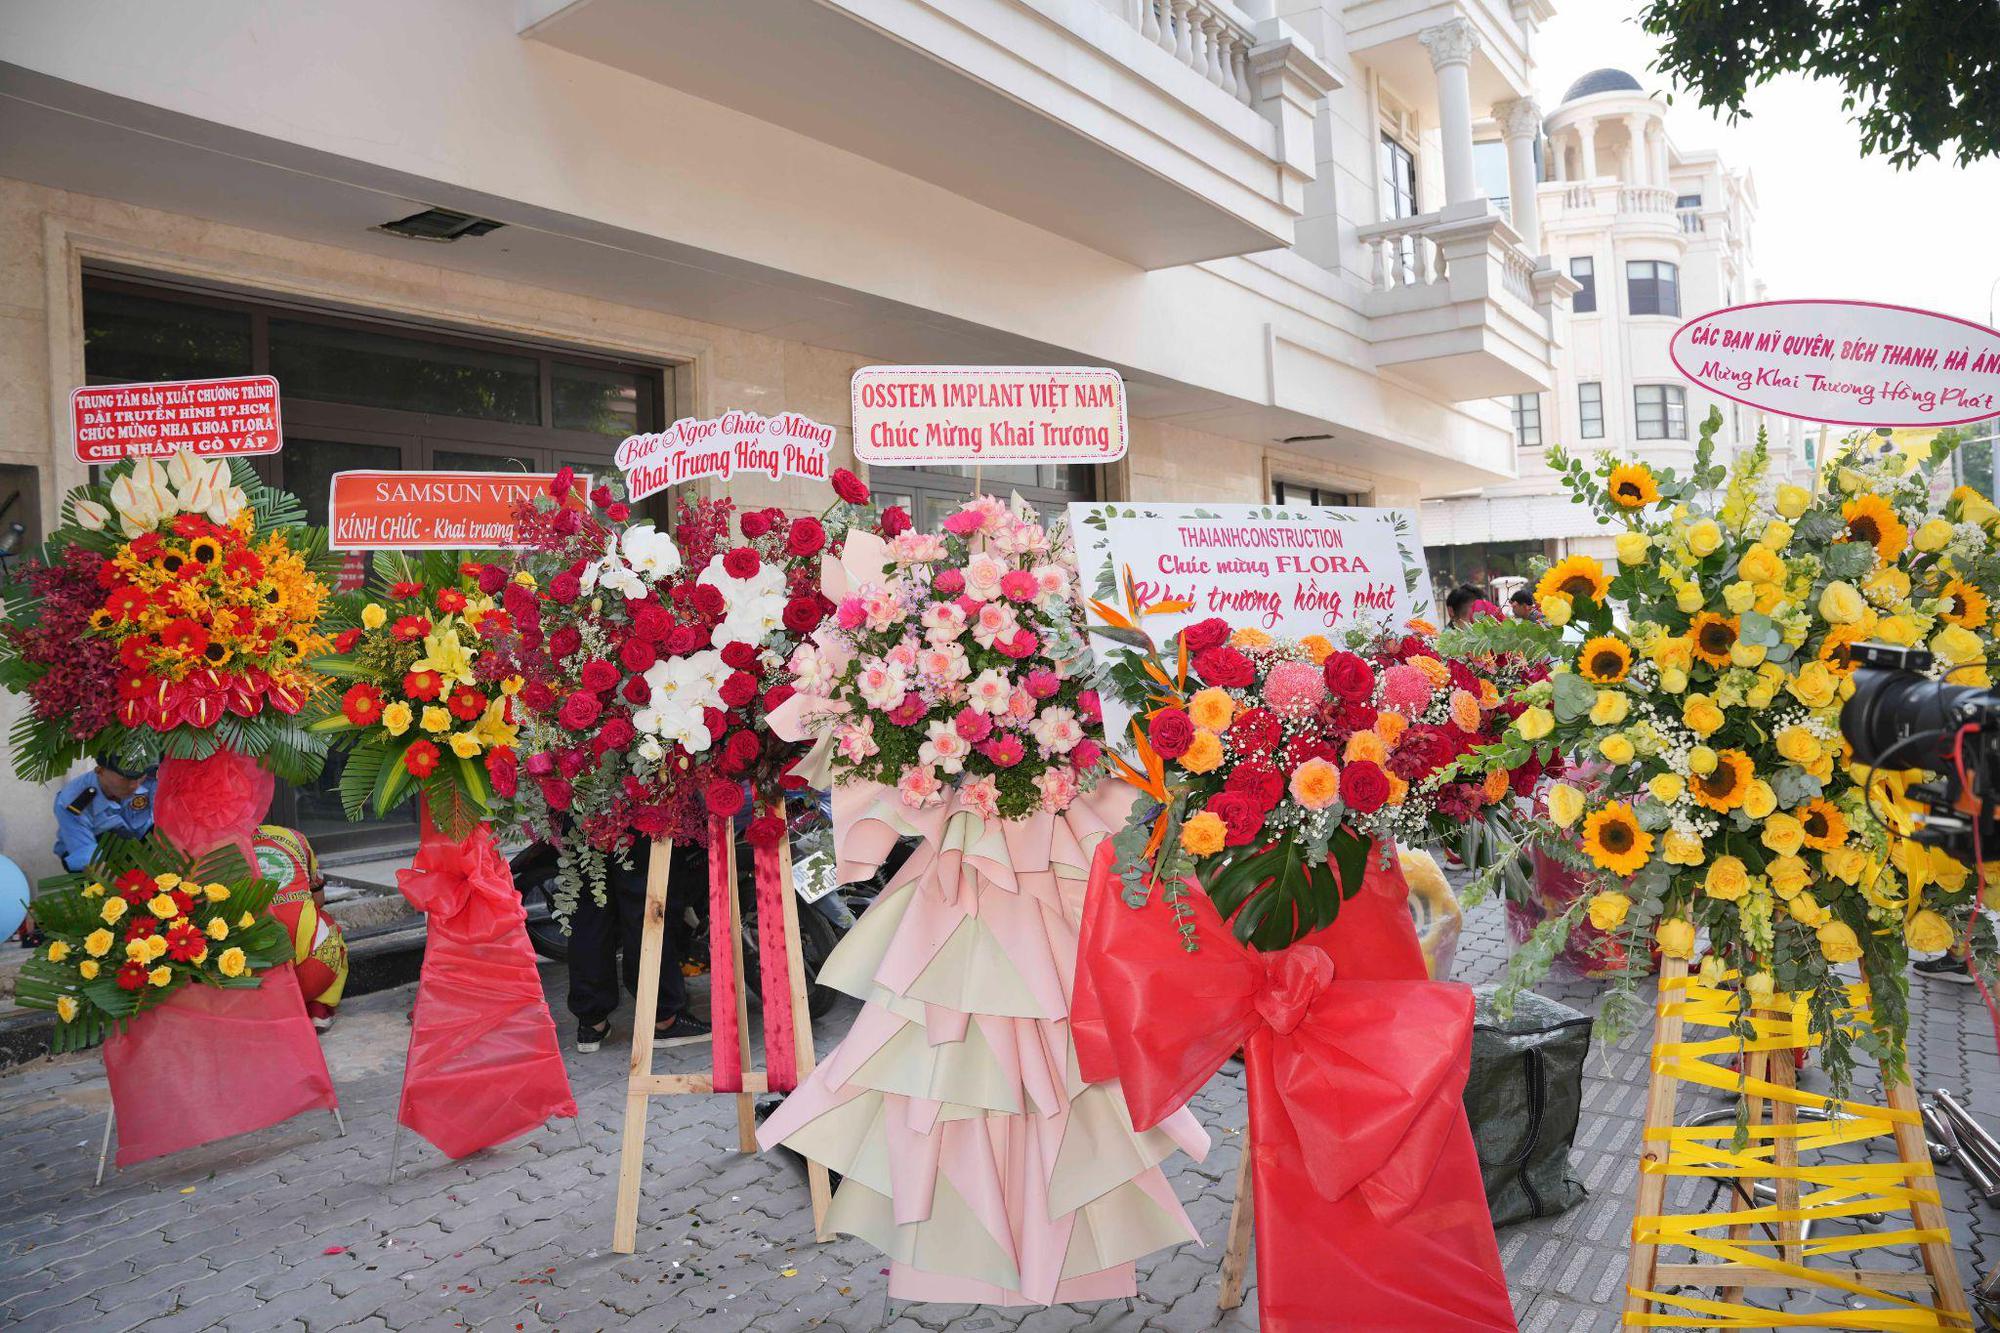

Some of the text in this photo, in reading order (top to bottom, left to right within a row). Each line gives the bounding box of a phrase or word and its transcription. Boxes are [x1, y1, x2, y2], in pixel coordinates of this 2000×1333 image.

[1691, 323, 2000, 375] CÁC BẠN MỸ QUYÊN, BÍCH THANH, HÀ ÁN
[77, 395, 114, 409] TRUNG
[116, 390, 140, 407] TÂM
[197, 385, 239, 402] CHƯƠNG
[241, 382, 273, 399] TRÌNH
[862, 377, 1115, 414] OSSTEM IMPLANT VIỆT NAM
[1696, 361, 1993, 412] Mừng Khai Trương Hồng Phát
[84, 403, 270, 424] ĐÀI TRUYỀN HÌNH TP.HCM
[79, 417, 274, 440] CHÚC MỪNG NHA KHOA FLORA
[618, 414, 833, 465] Bác Ngọc Chúc Mừng
[870, 419, 1109, 453] Chúc Mừng Khai Trương
[89, 432, 268, 457] CHI NHÁNH GÒ VẤP
[630, 438, 824, 498] Khai Trương Hồng Phát
[376, 482, 546, 503] SAMSUN VINA
[337, 512, 377, 539] KÍNH
[380, 512, 423, 540] CHÚC
[434, 517, 466, 539] Khai
[470, 518, 515, 541] trương
[1178, 527, 1344, 549] THAIANHCONSTRUCTION
[1157, 553, 1371, 577] Chúc mừng FLORA
[1208, 585, 1284, 629] trương
[1294, 578, 1343, 627] hồng
[1353, 582, 1396, 619] phát
